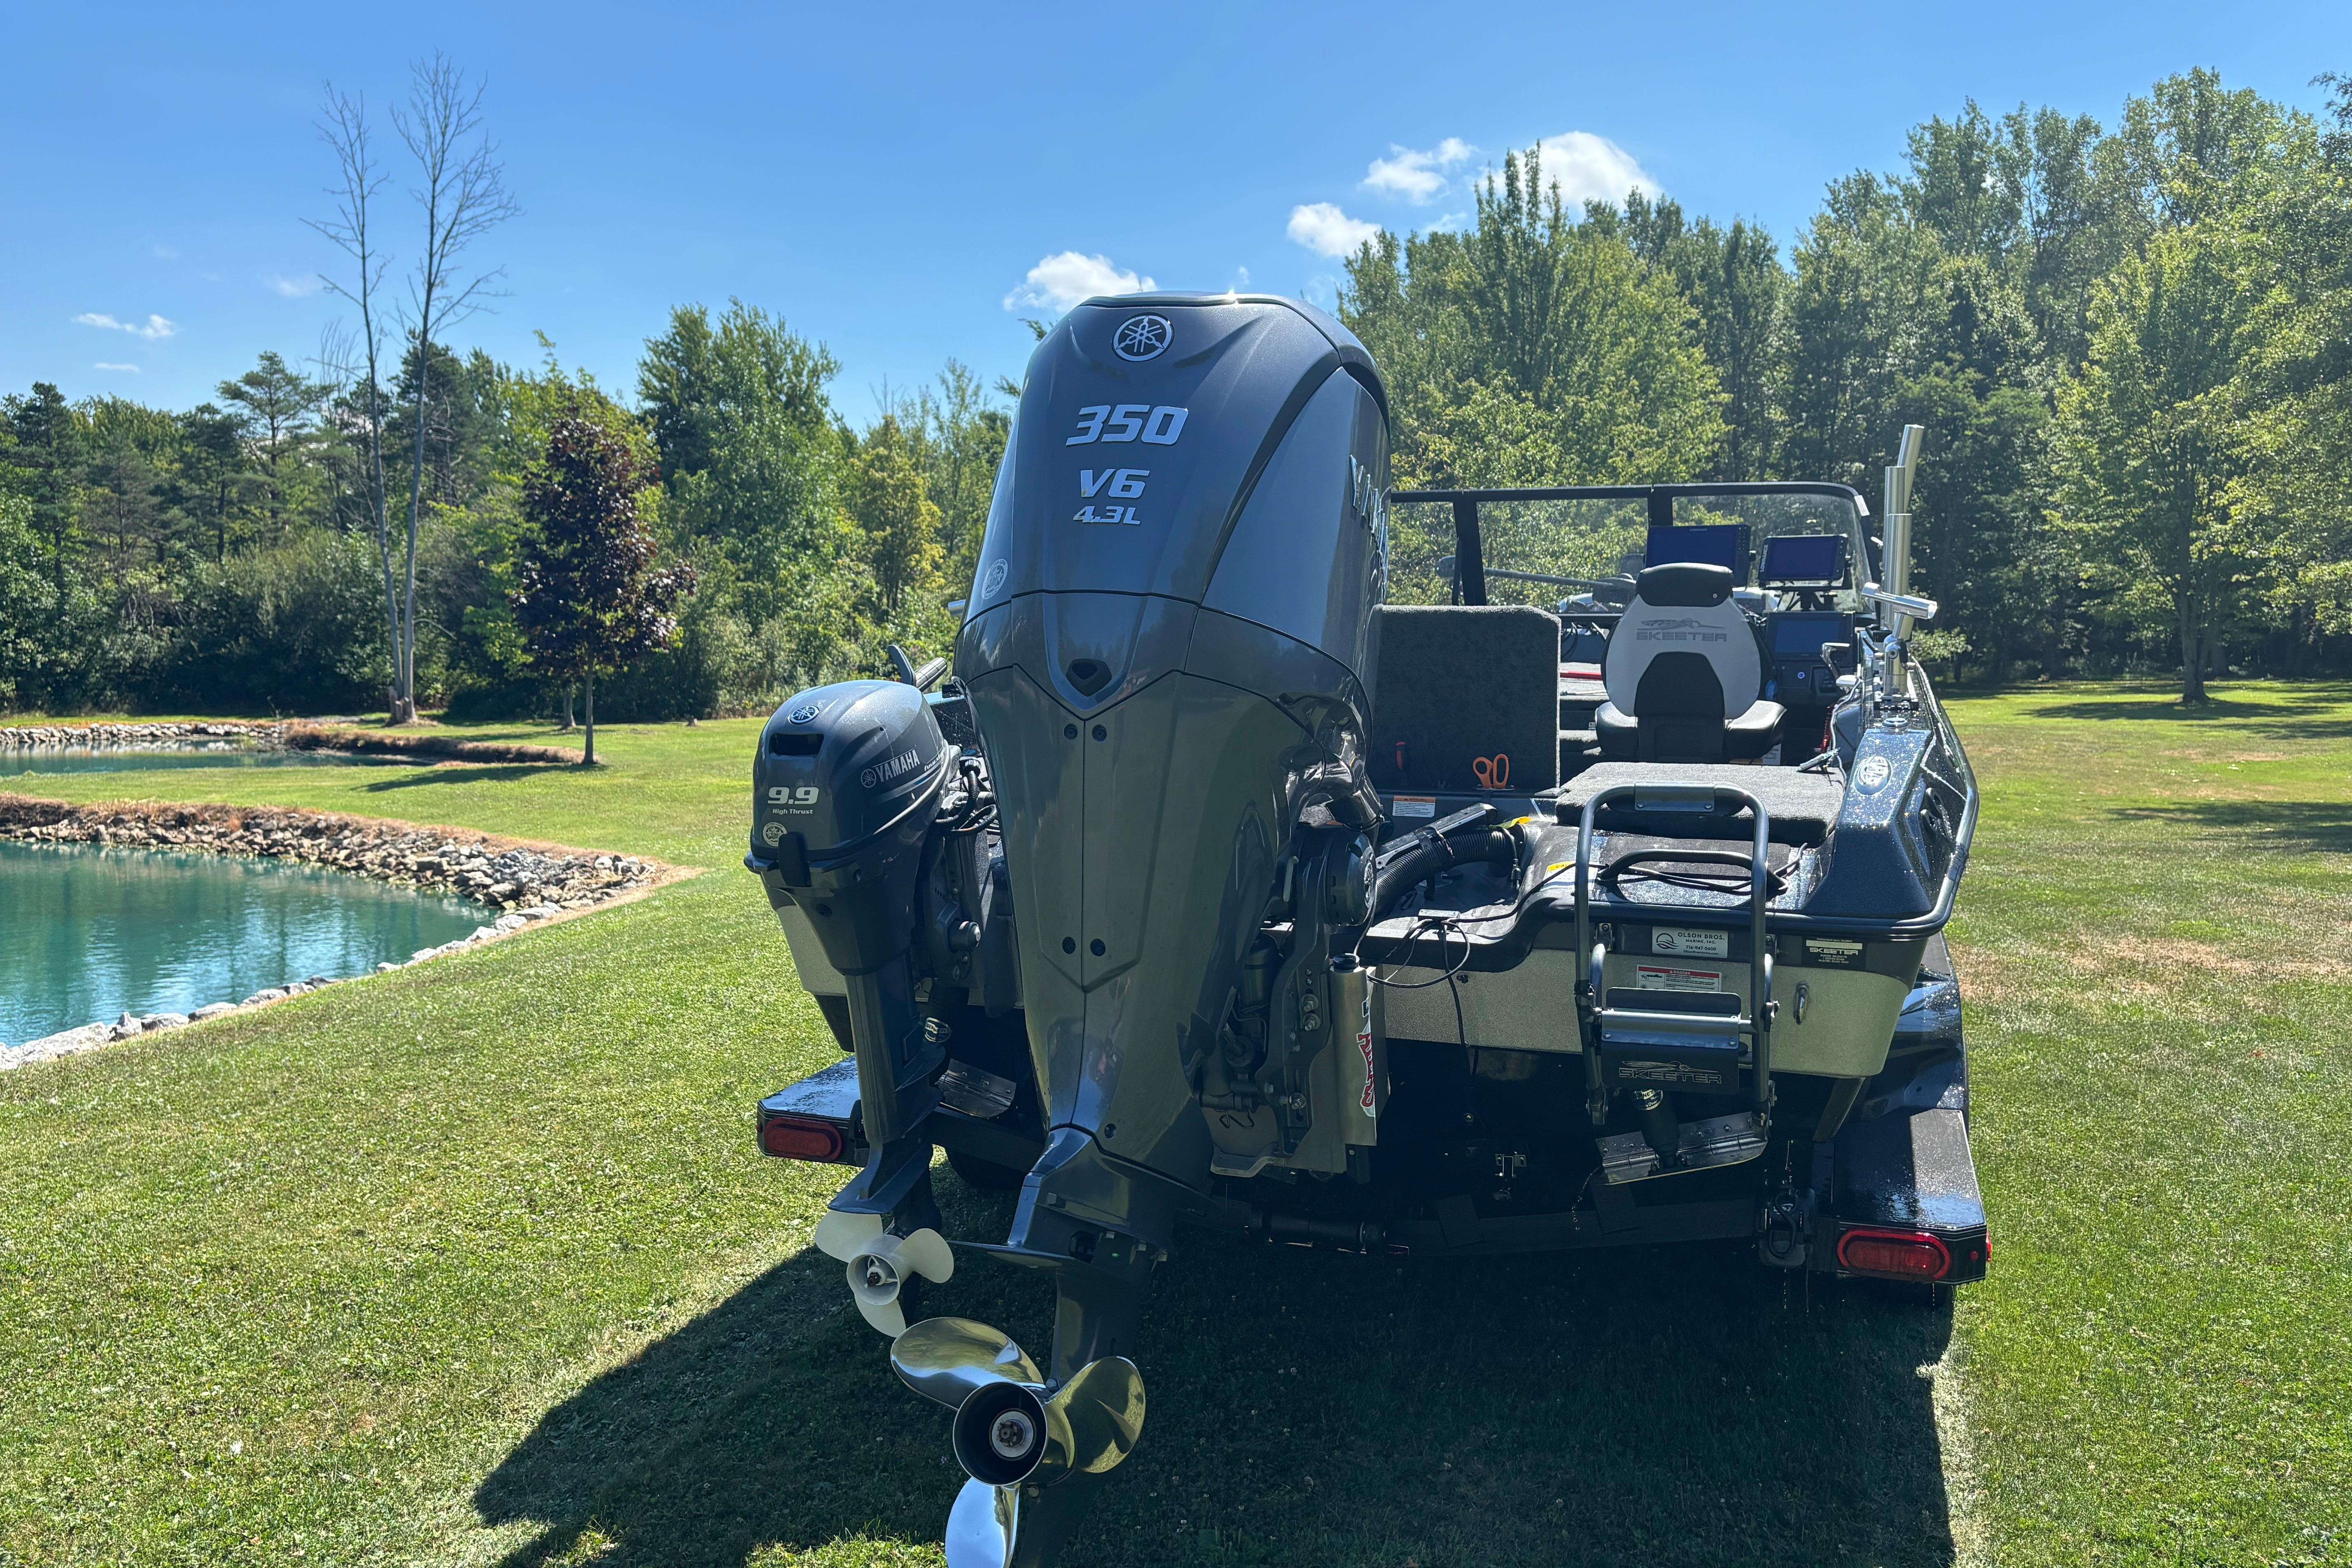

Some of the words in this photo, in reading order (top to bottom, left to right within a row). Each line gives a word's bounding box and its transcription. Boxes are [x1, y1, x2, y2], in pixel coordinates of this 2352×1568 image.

[1065, 404, 1188, 446] 350
[1080, 469, 1150, 499] V6
[1073, 505, 1141, 525] 4.3L
[1636, 631, 1727, 642] SKEETER
[875, 749, 921, 782] YAMAHA
[768, 786, 819, 805] 9.9
[1618, 1067, 1722, 1084] SKEETER
